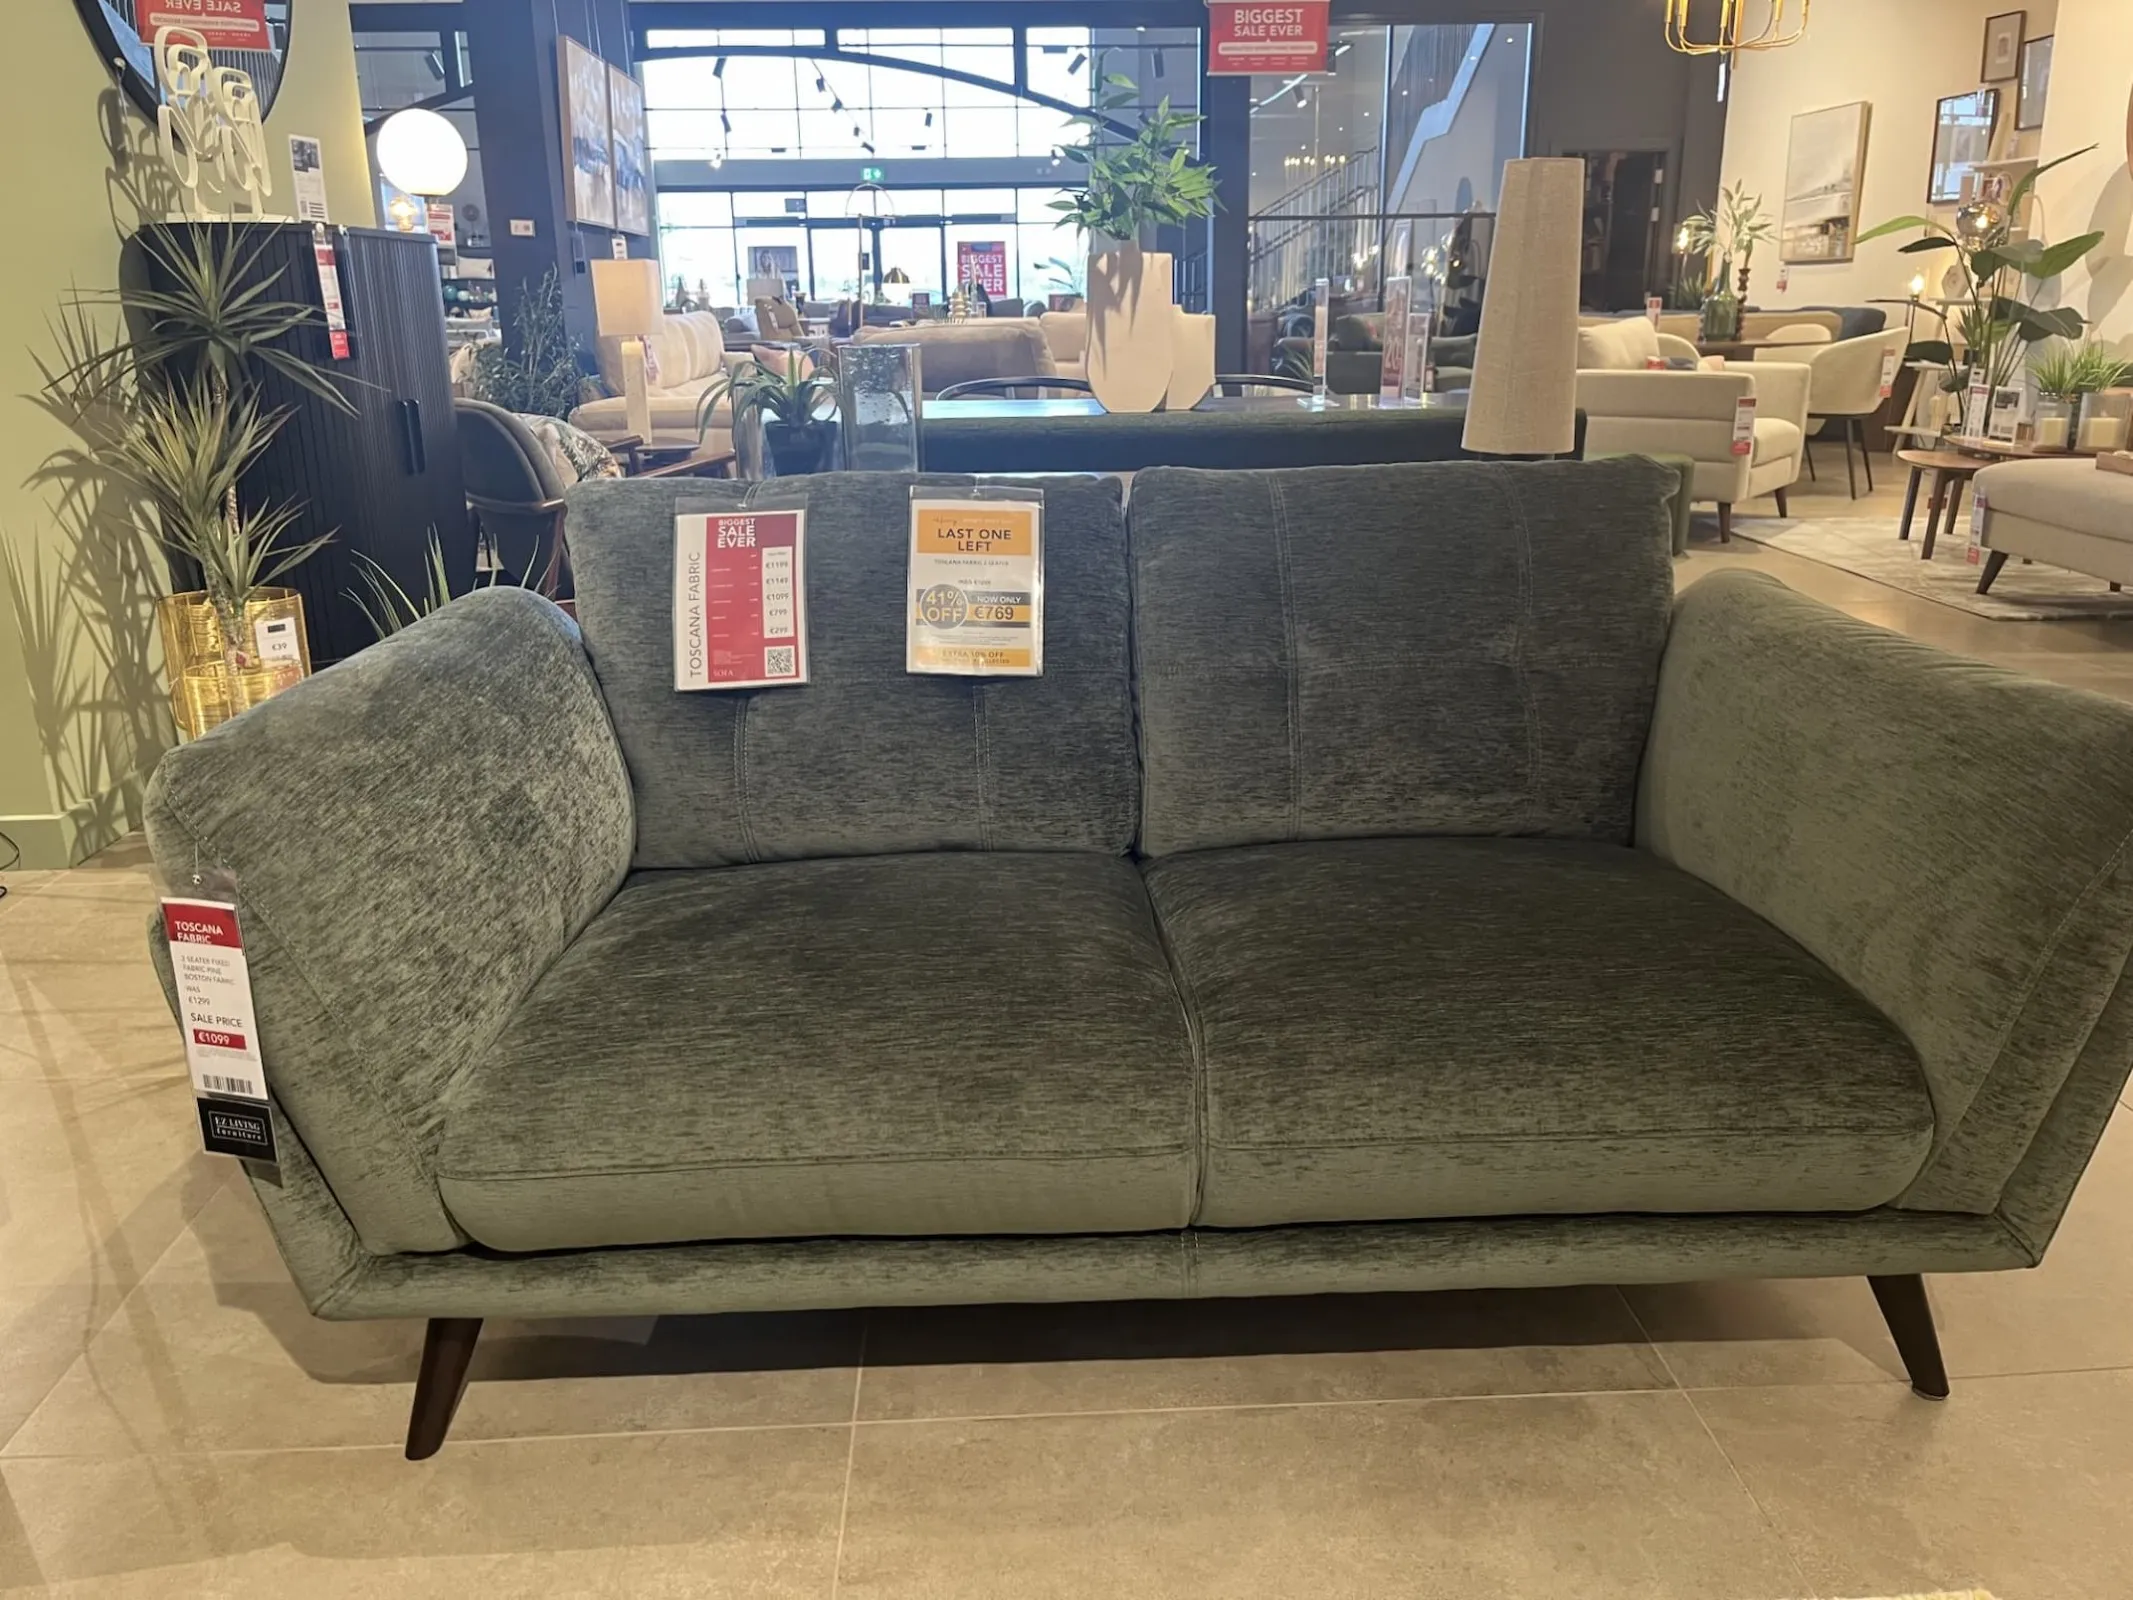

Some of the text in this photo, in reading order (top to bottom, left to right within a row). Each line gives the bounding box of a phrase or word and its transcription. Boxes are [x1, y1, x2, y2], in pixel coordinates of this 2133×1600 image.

[1234, 9, 1304, 24] BIGGEST
[1234, 25, 1303, 37] SALE EVER
[718, 518, 755, 526] BIGGEST
[718, 526, 755, 537] SALE
[938, 528, 1012, 540] LAST ONE
[717, 536, 756, 548] EVER
[958, 540, 992, 552] LEFT
[978, 595, 1022, 604] NOW ONLY
[927, 591, 964, 622] 41% OFF
[688, 552, 702, 678] TOSCANA FABRIC
[975, 606, 1014, 621] €769
[174, 921, 224, 936] TOSCANA
[177, 933, 212, 944] FABRIC
[190, 1012, 243, 1028] SALE PRICE
[198, 1032, 230, 1045] €1099
[229, 1118, 260, 1130] LIVING
